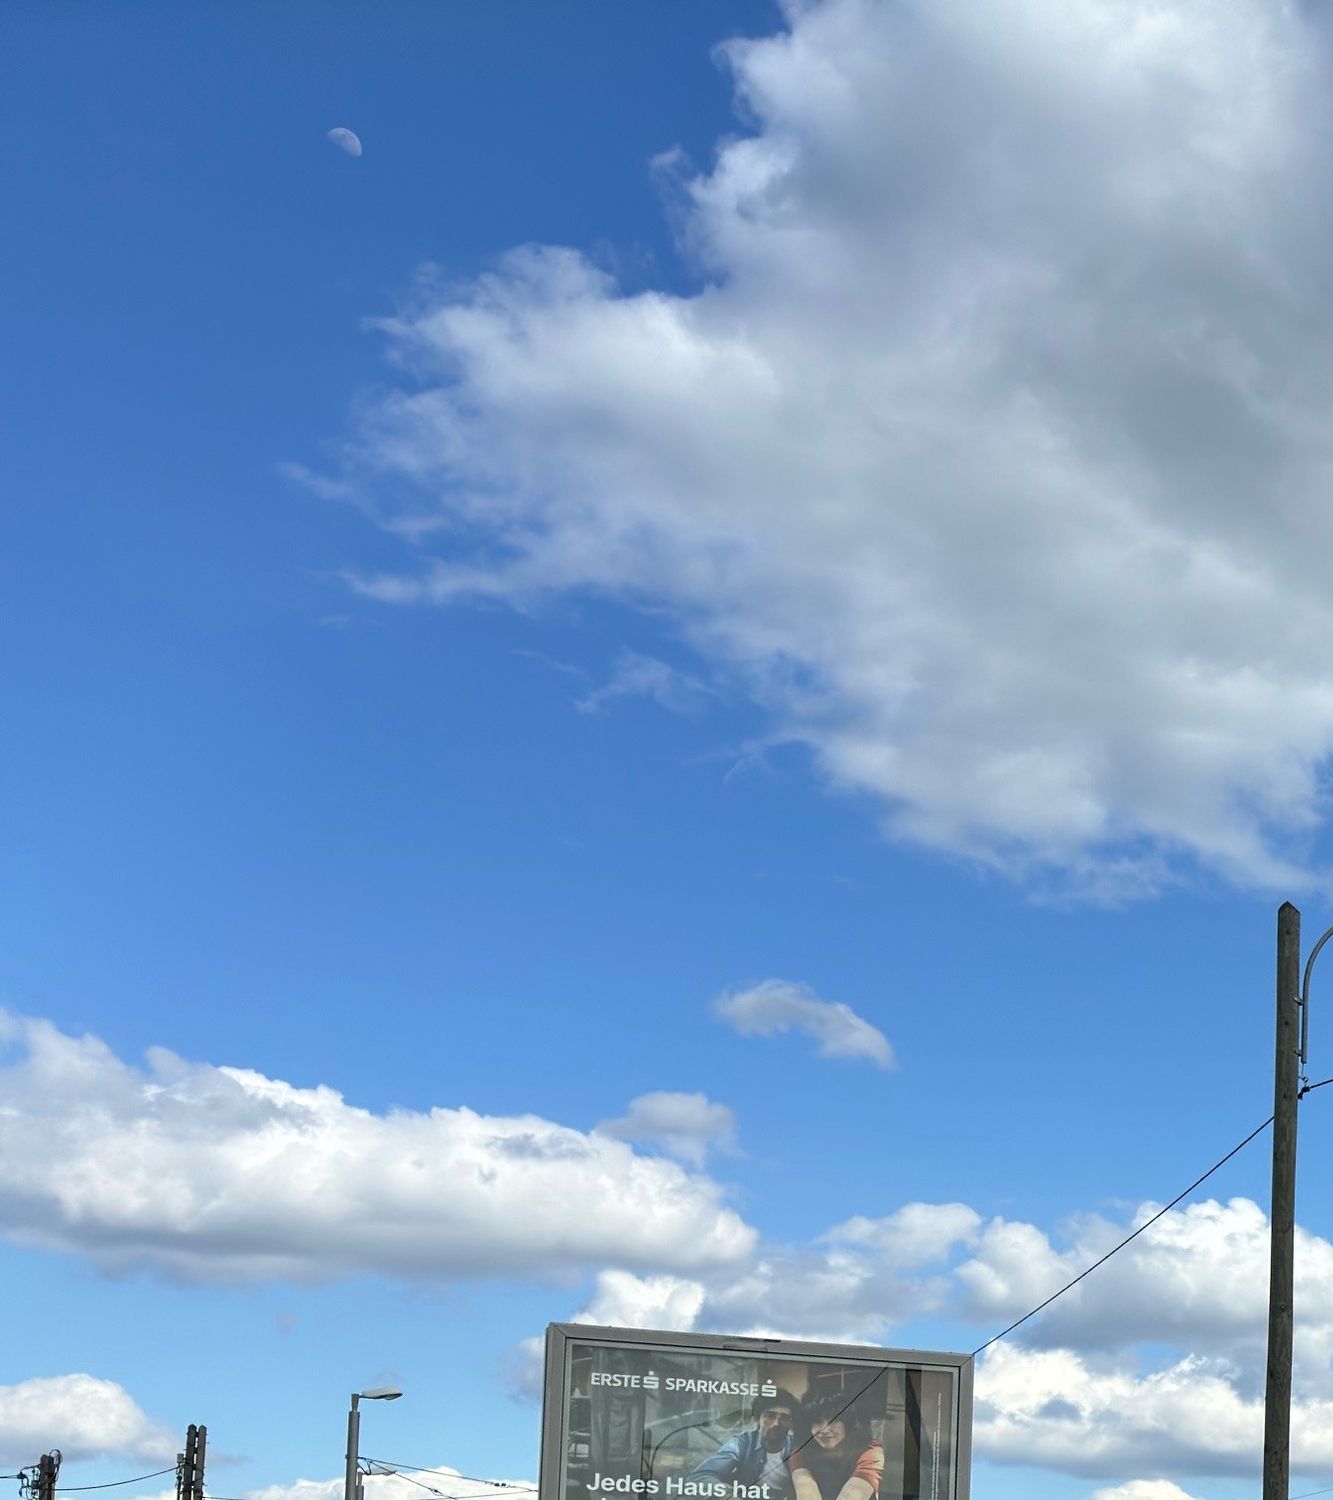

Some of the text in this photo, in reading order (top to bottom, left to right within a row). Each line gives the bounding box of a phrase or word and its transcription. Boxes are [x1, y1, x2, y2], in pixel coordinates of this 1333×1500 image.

[591, 1372, 759, 1396] ERSTE SPARKASSE
[586, 1473, 770, 1500] Jedes Haus hat
